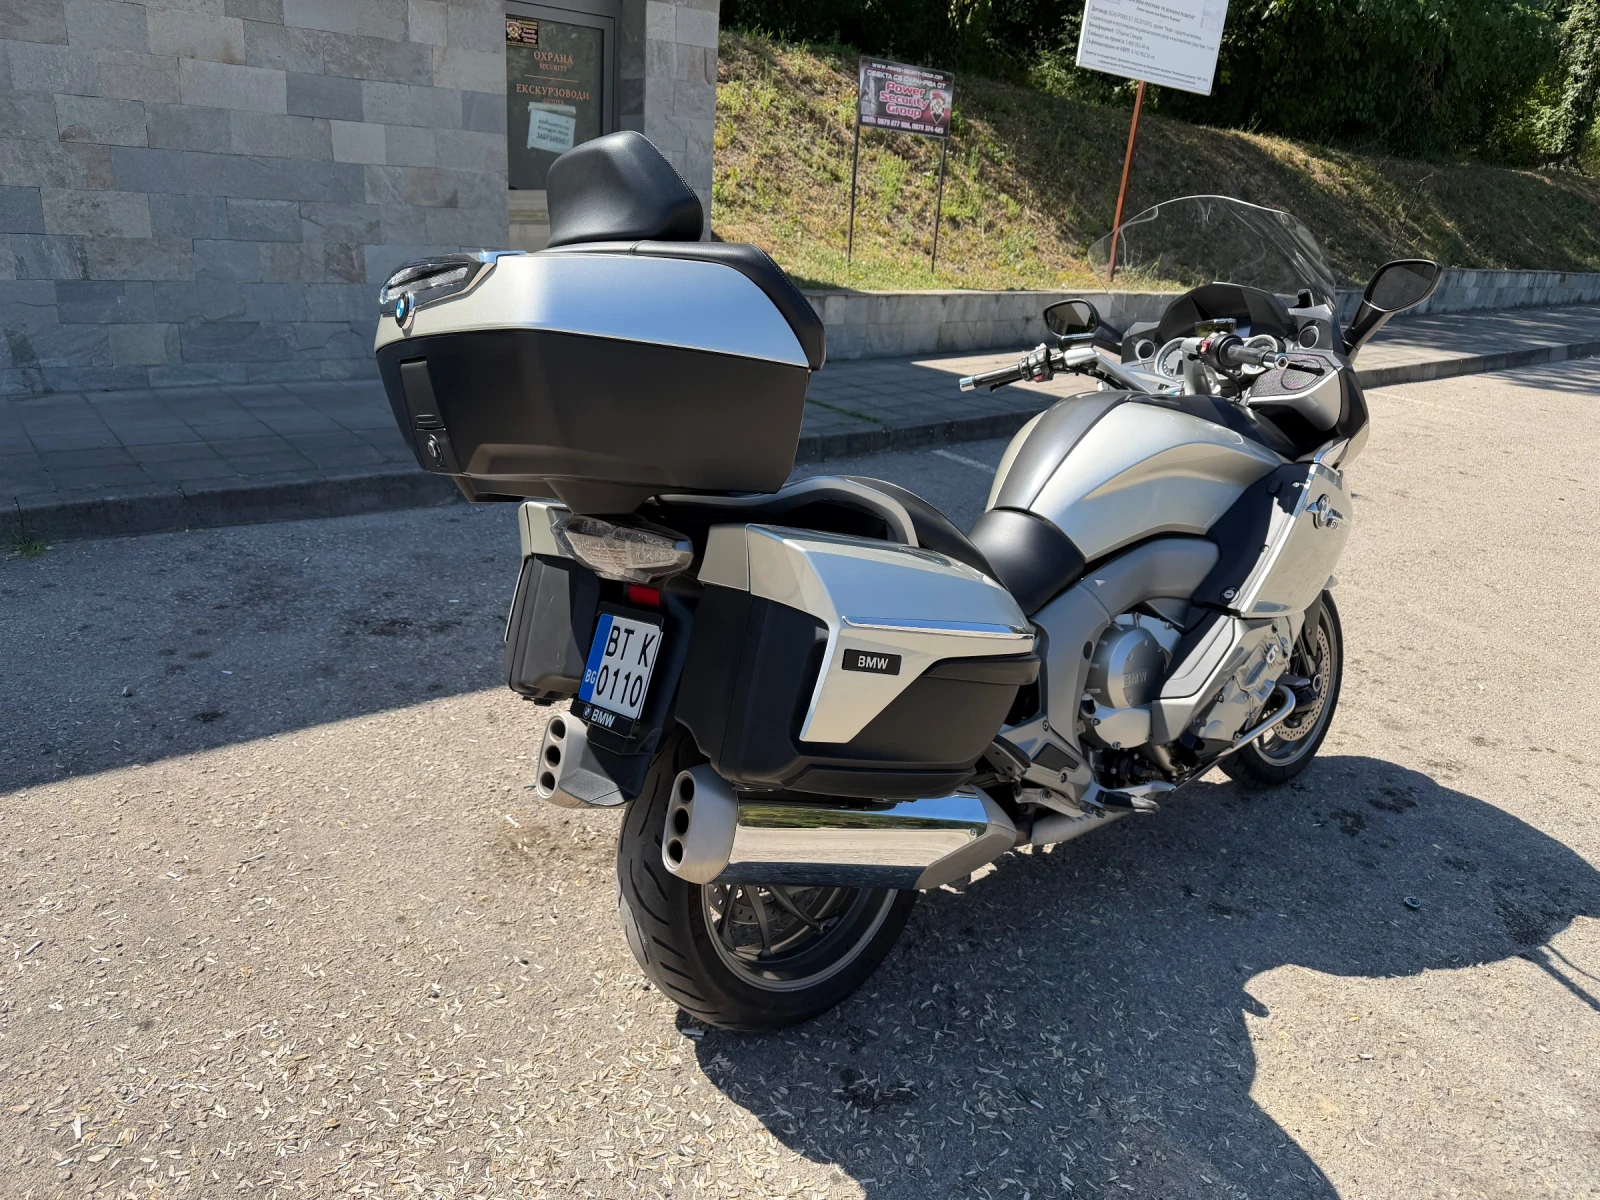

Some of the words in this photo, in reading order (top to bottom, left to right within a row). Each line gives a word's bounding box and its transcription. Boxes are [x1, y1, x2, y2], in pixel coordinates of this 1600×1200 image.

[534, 50, 573, 64] ОХРАНА
[539, 63, 568, 72] SECURITY
[516, 84, 590, 100] ЕКСКУРЗОВОДИ
[885, 81, 926, 96] Power
[879, 90, 930, 109] Security
[886, 103, 922, 120] Group
[605, 626, 634, 661] BT
[638, 633, 656, 668] K
[858, 655, 889, 669] BMW
[585, 669, 597, 685] BG
[1124, 671, 1147, 687] BMW
[596, 665, 643, 708] 0110
[592, 709, 616, 728] BMW
